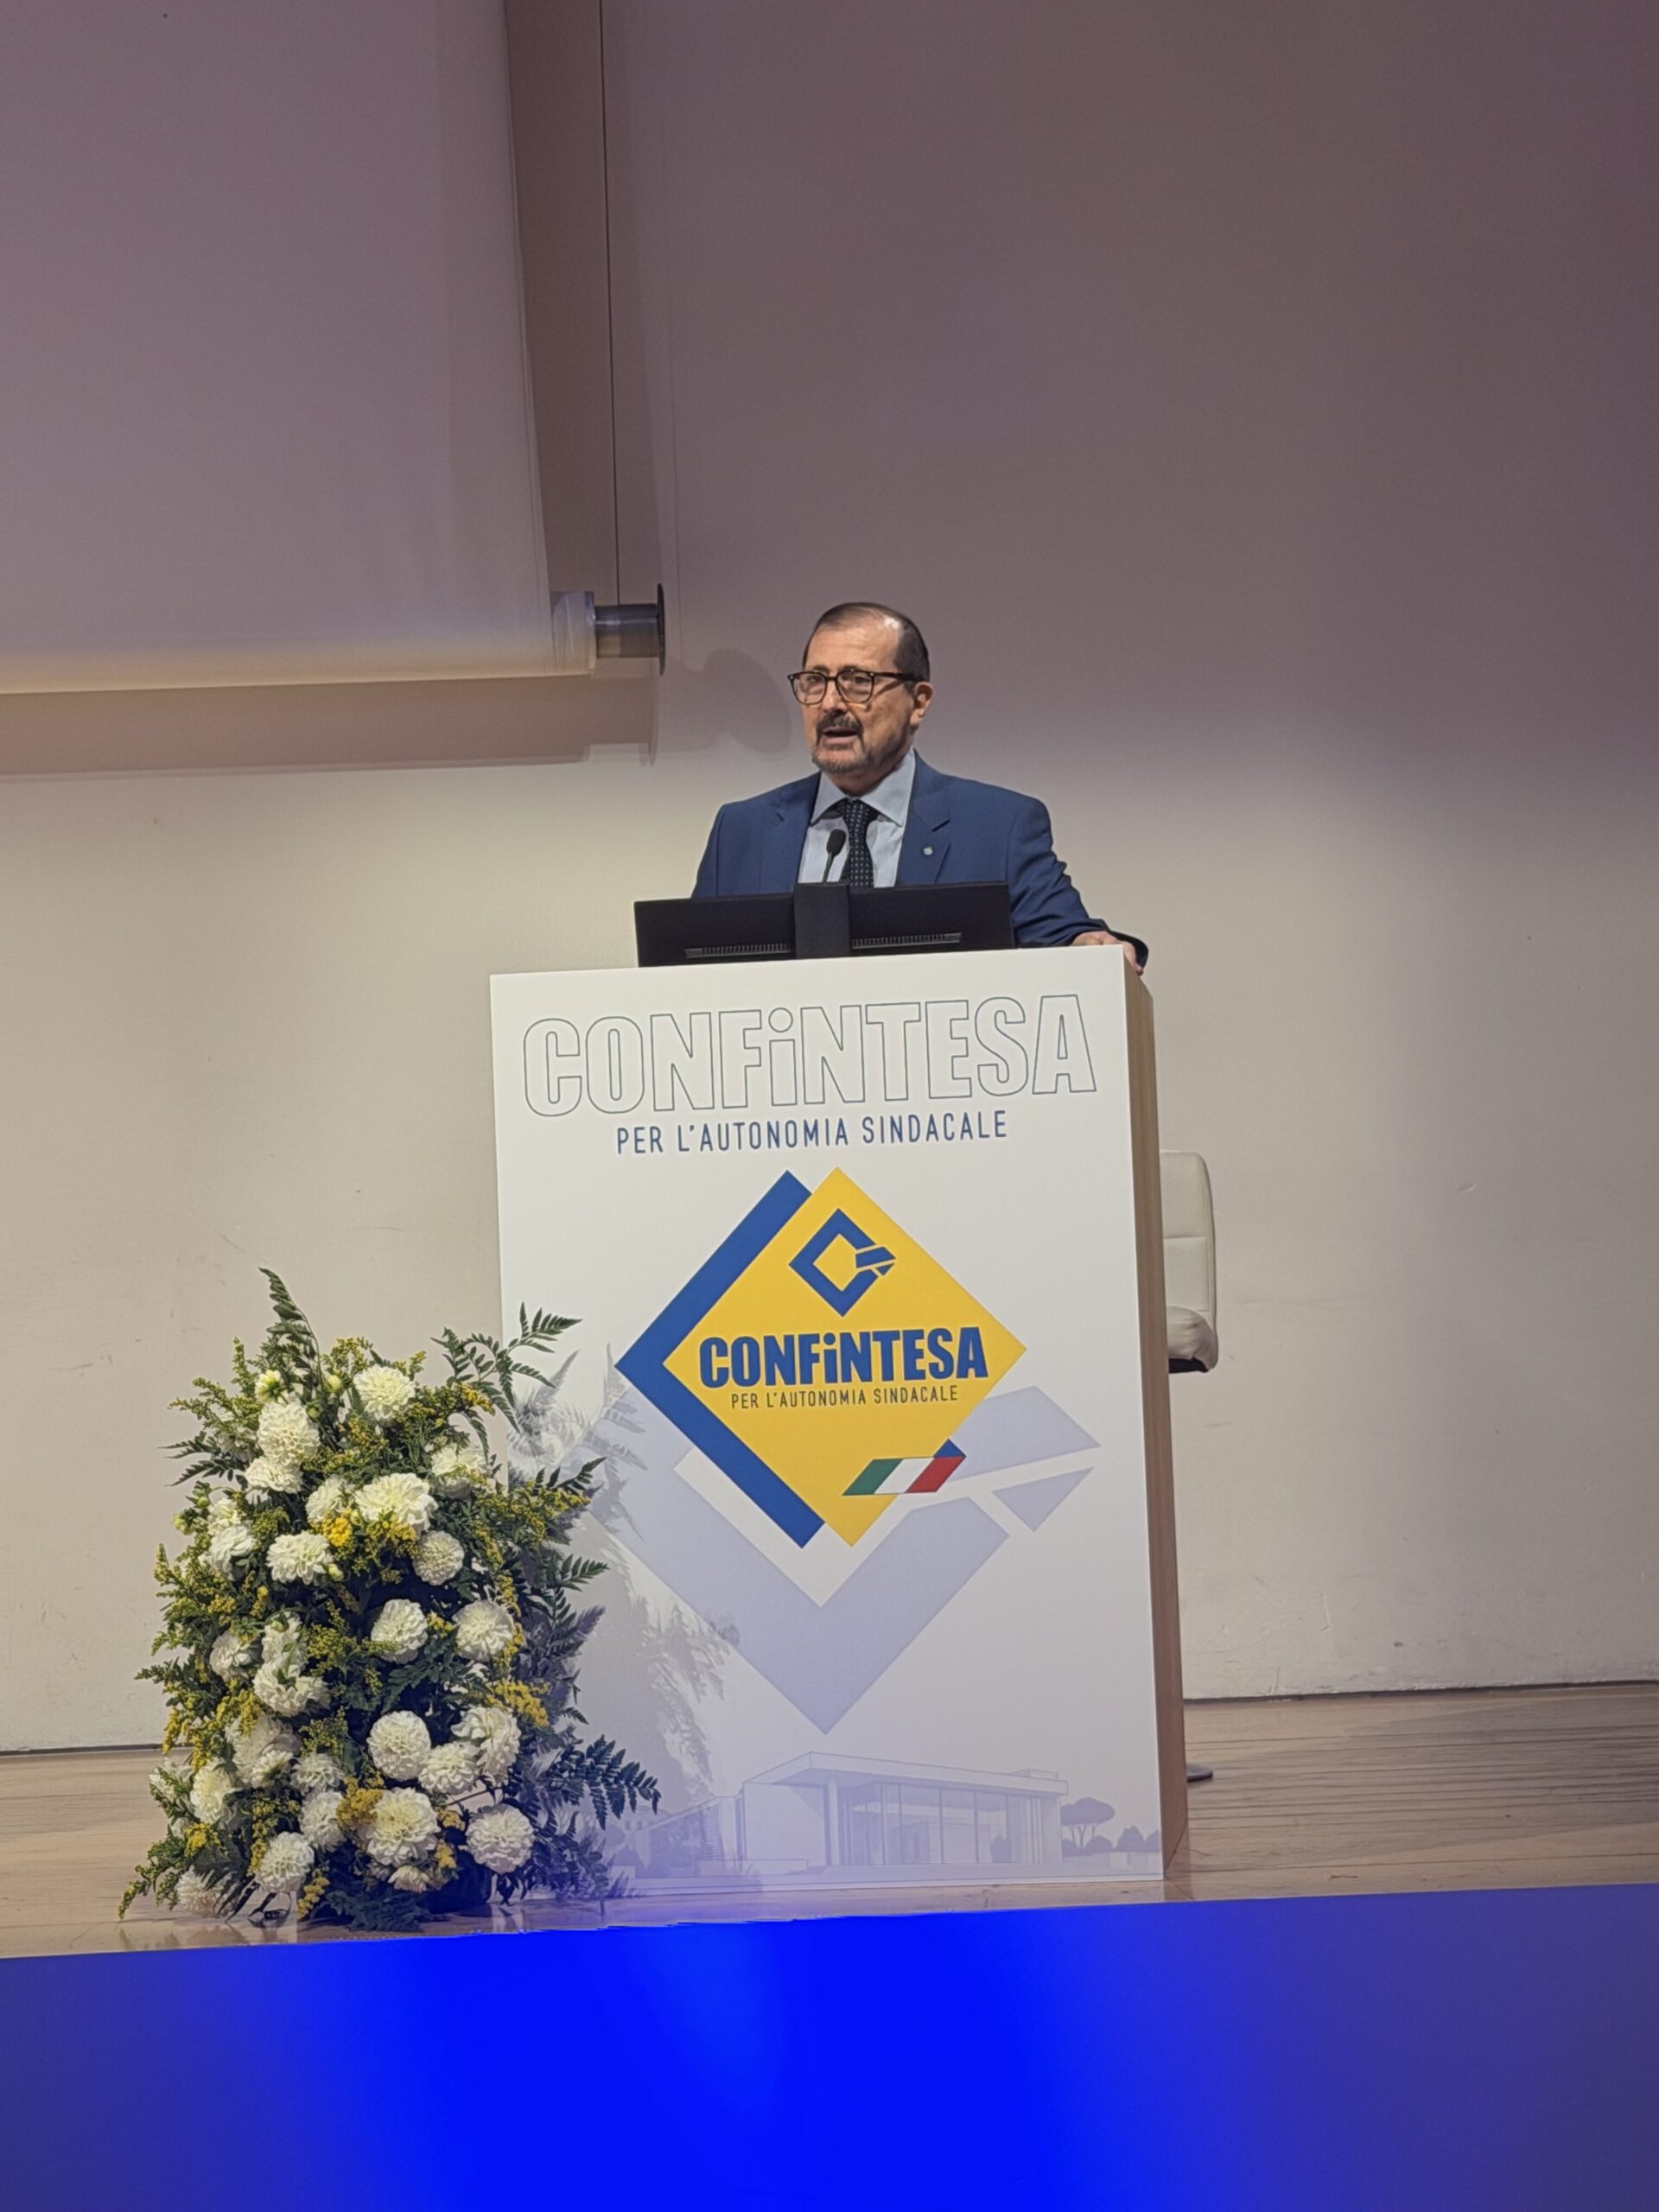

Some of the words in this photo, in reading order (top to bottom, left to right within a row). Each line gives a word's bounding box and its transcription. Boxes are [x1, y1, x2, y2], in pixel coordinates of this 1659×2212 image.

[616, 1125, 664, 1155] PER
[677, 1117, 850, 1153] L'AUTONOMIA
[861, 1109, 1008, 1145] SINDACALE
[731, 1392, 760, 1410] PER
[766, 1389, 867, 1408] L'AUTONOMIA
[873, 1384, 958, 1405] SINDACALE
